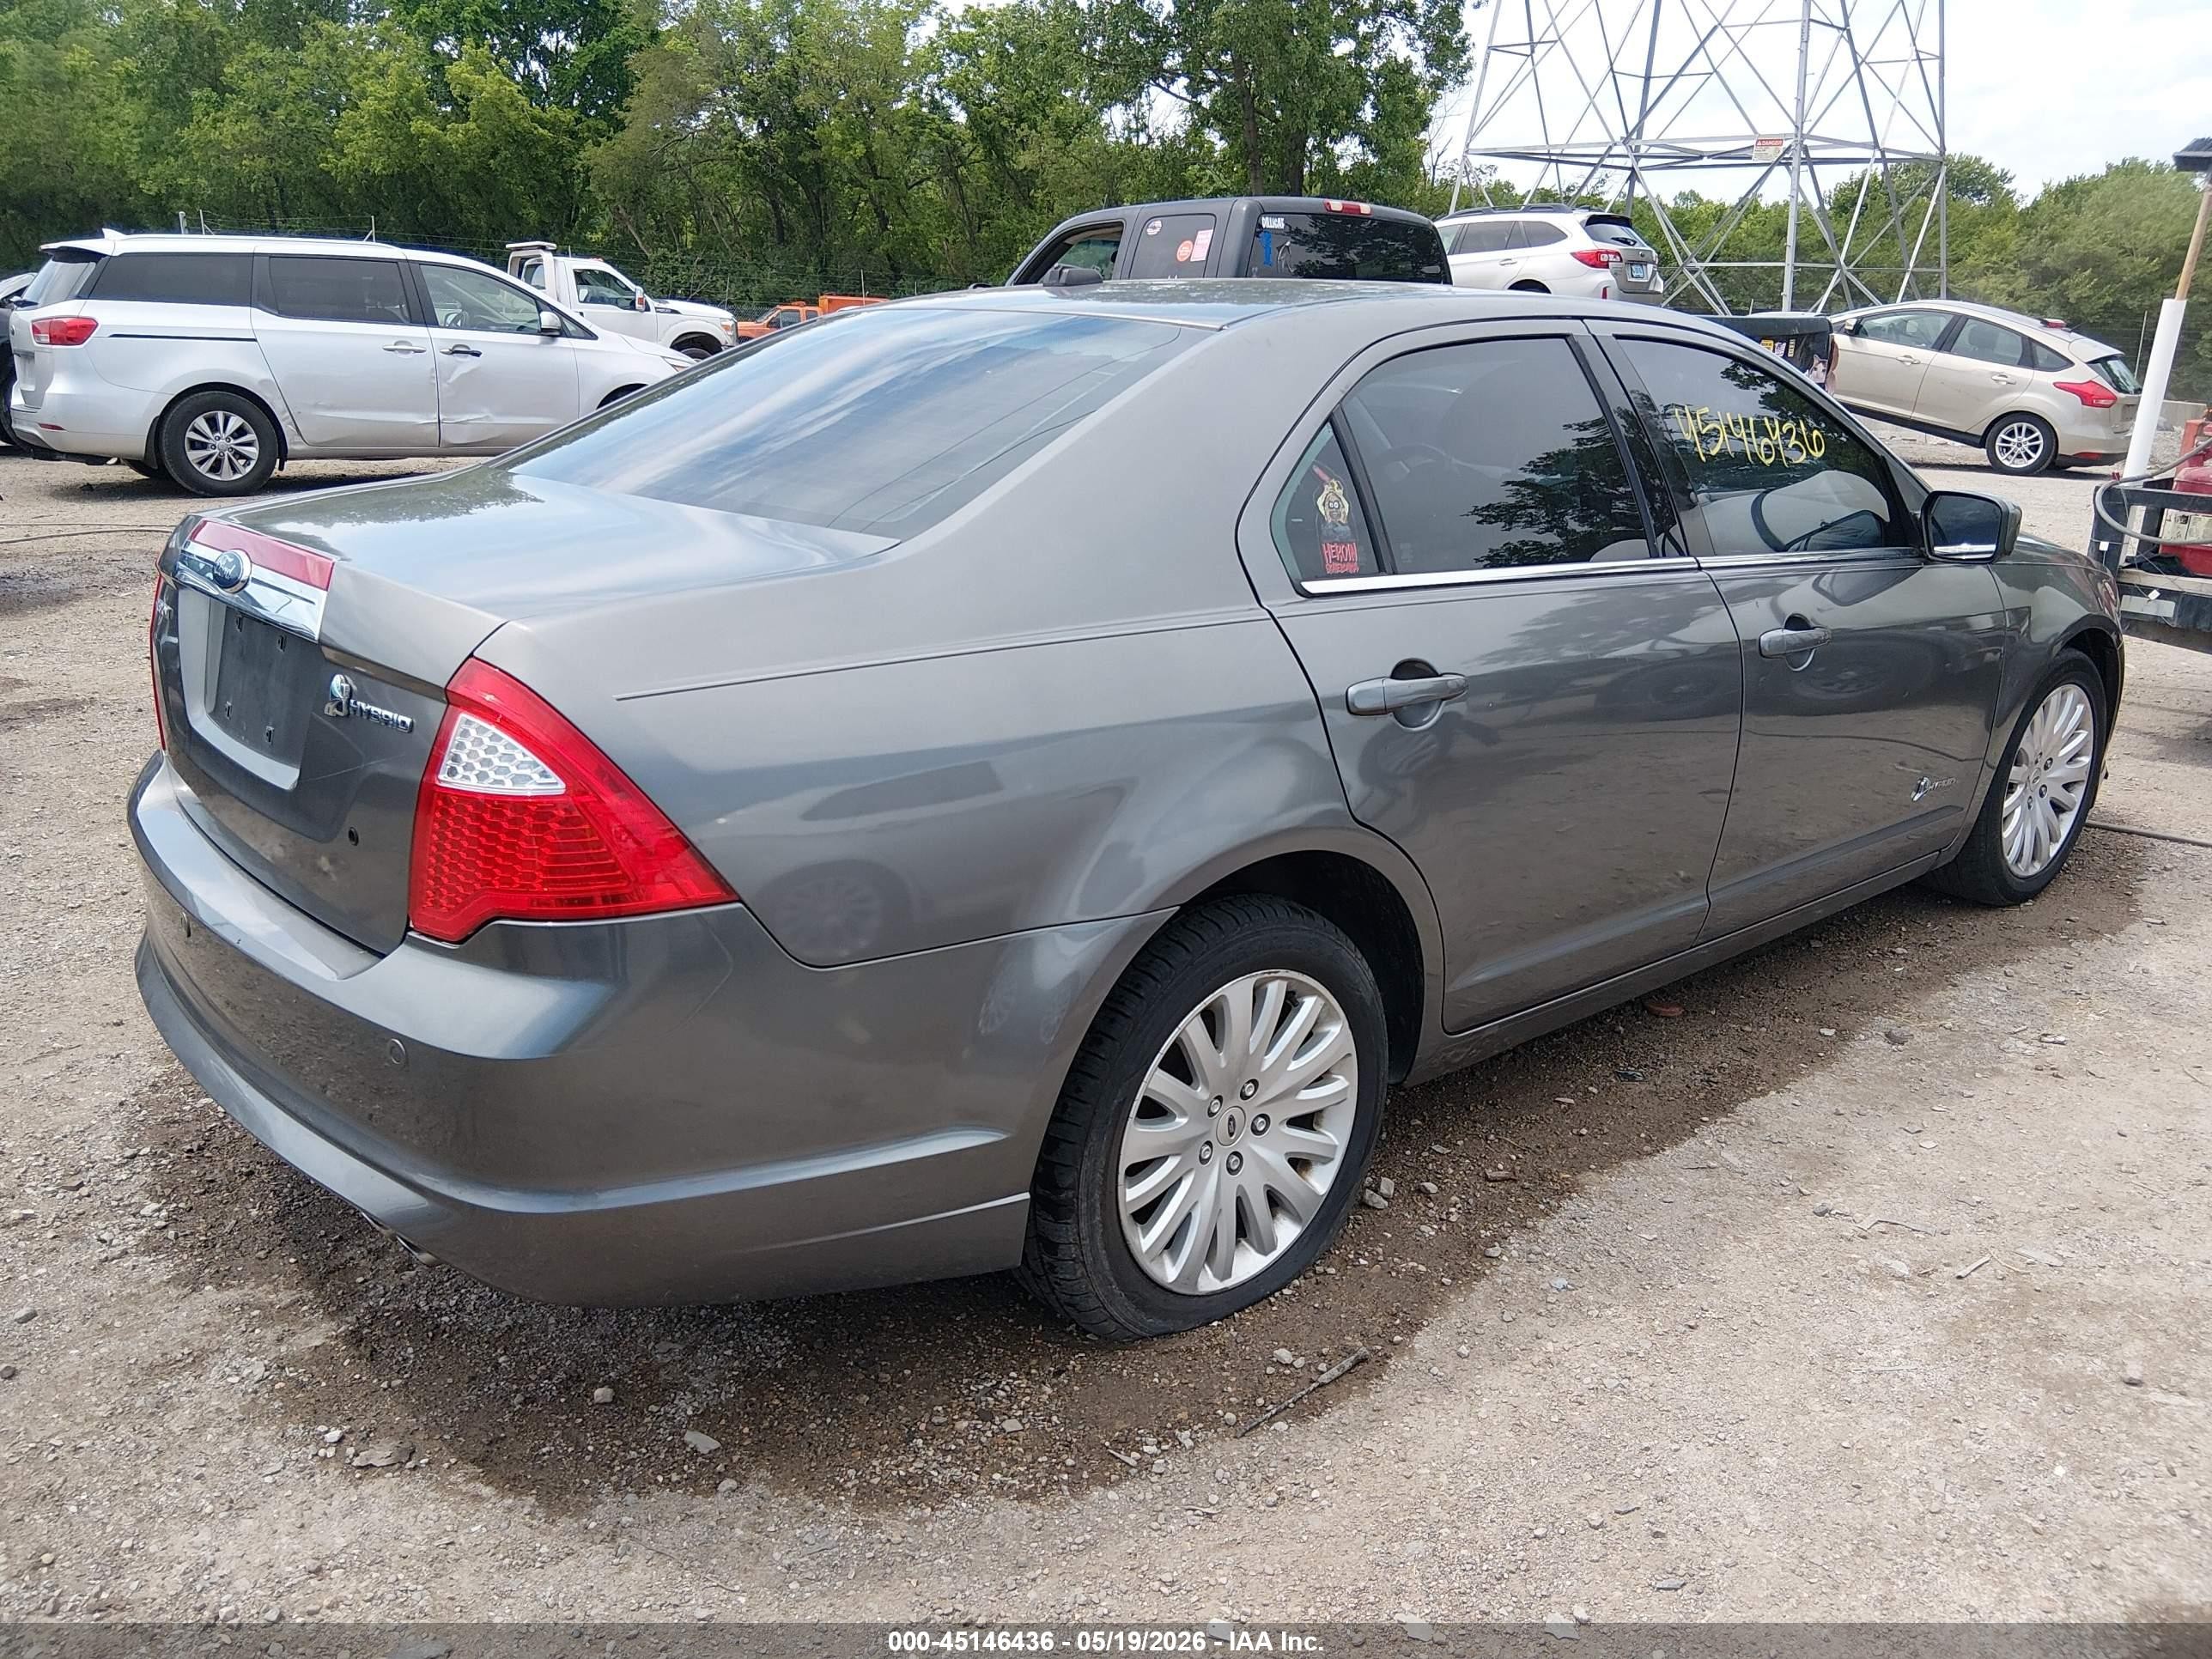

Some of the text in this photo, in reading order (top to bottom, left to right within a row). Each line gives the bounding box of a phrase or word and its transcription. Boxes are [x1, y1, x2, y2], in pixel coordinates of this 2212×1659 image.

[1675, 405, 1826, 468] 45146436
[1322, 542, 1358, 564] HEROIN
[349, 699, 414, 733] HYBRID
